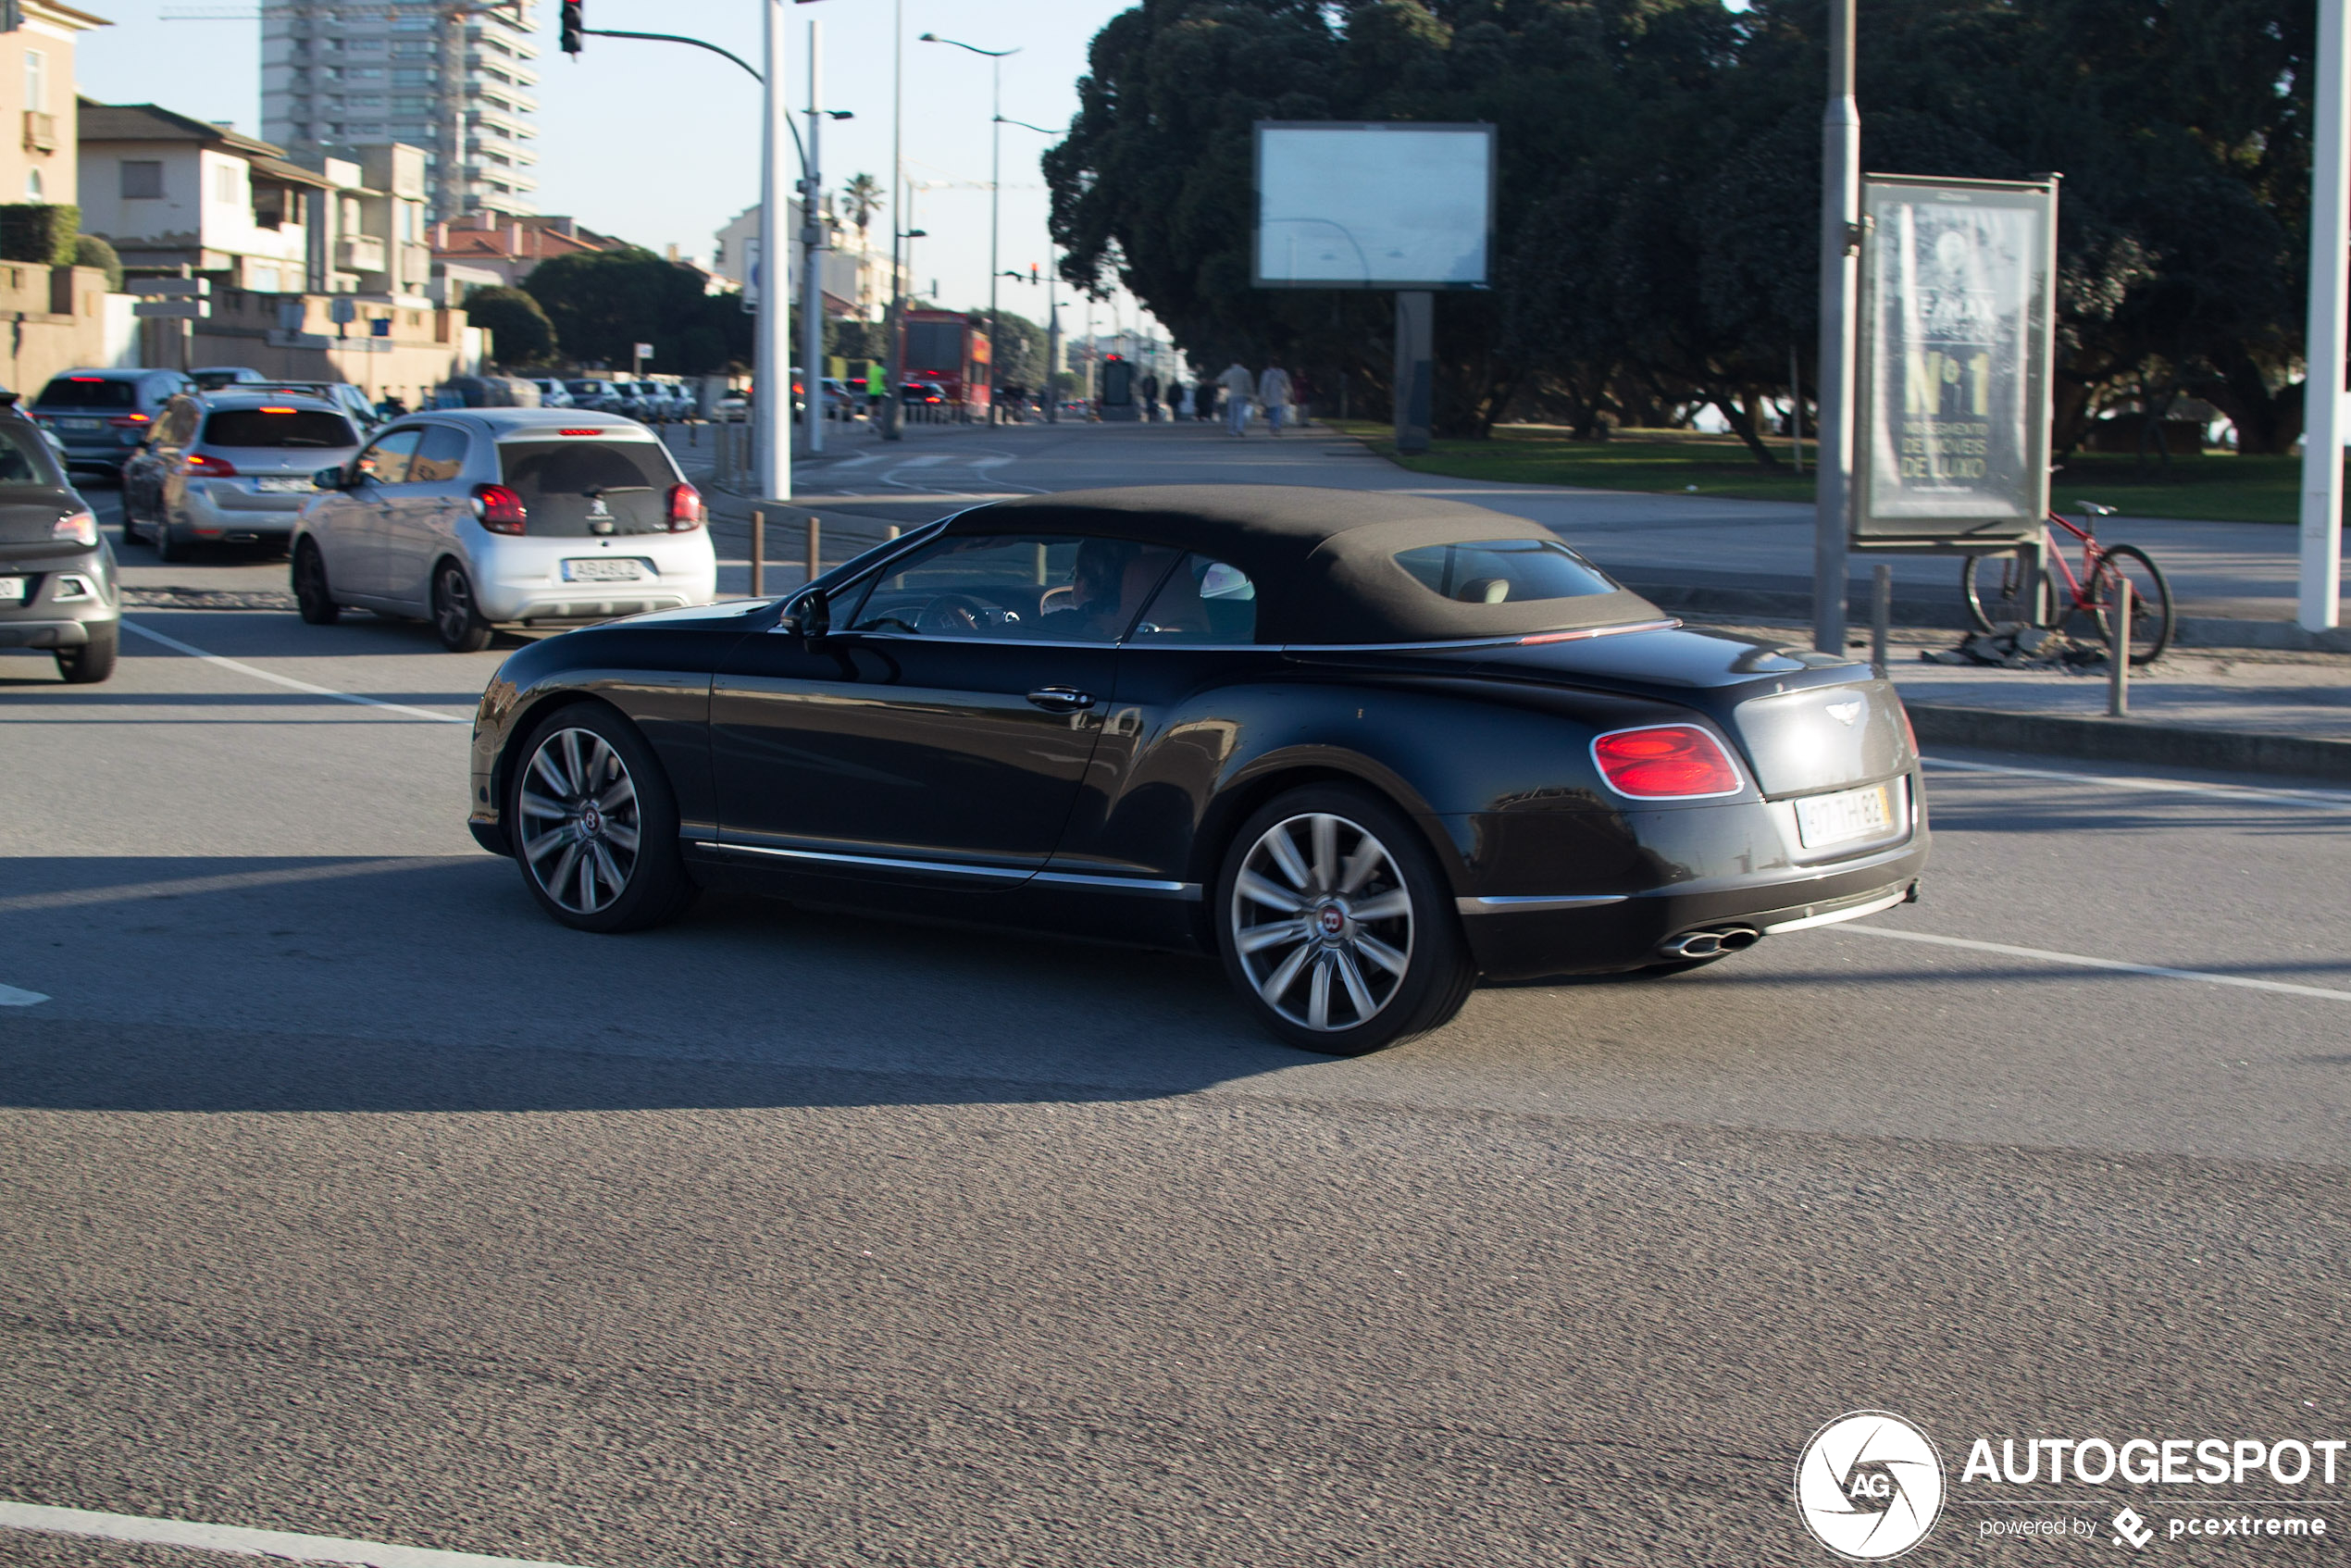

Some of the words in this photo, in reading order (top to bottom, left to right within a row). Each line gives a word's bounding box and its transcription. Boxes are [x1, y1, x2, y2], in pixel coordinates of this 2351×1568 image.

[1968, 353, 1989, 416] 1
[1902, 437, 1923, 454] DE
[1900, 457, 1928, 479] DE
[1931, 457, 1987, 479] LUXO
